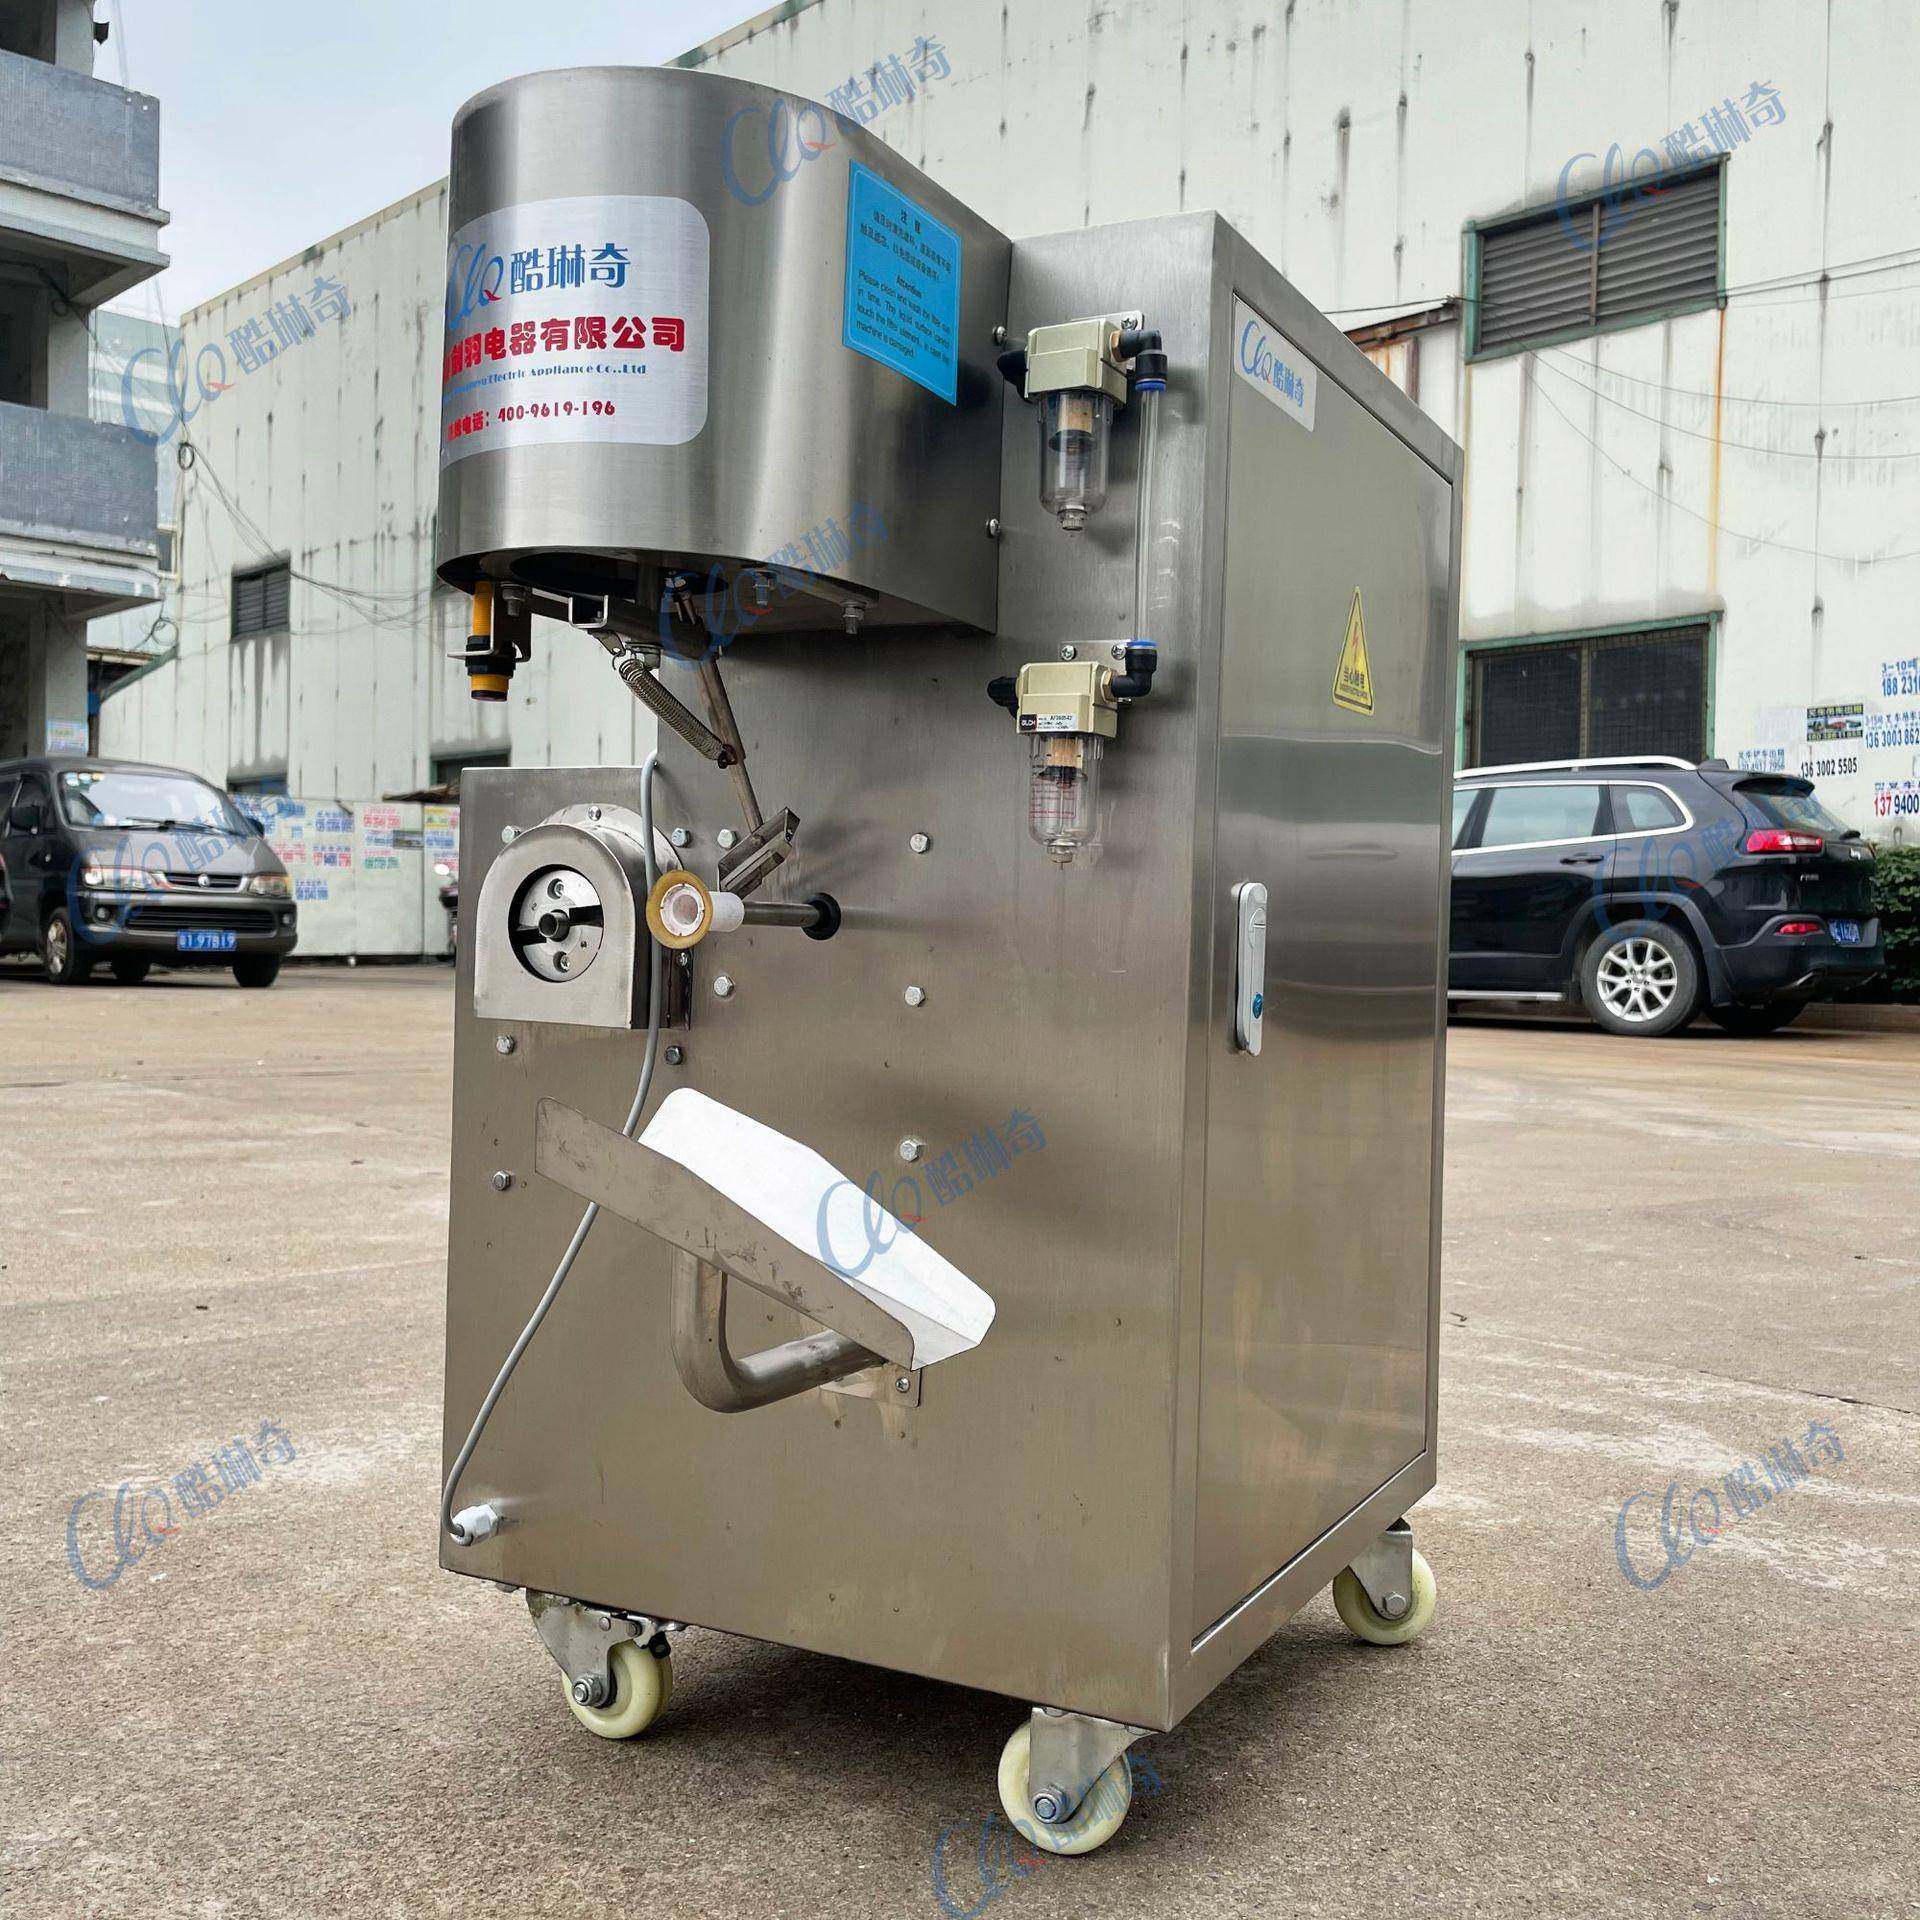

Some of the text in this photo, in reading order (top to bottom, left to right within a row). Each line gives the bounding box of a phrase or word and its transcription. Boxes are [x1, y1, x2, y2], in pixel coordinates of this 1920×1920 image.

[510, 242, 631, 295] 酷琳奇
[858, 268, 879, 290] Please
[856, 301, 874, 320] touch
[856, 317, 882, 340] machine
[1273, 358, 1305, 408] 酷琳奇
[498, 400, 616, 423] 400-9619-196
[1865, 731, 1879, 748] 136
[1882, 729, 1902, 746] 3003
[1801, 761, 1814, 778] 136
[1816, 759, 1835, 776] 3002
[1874, 794, 1920, 816] 137 9400
